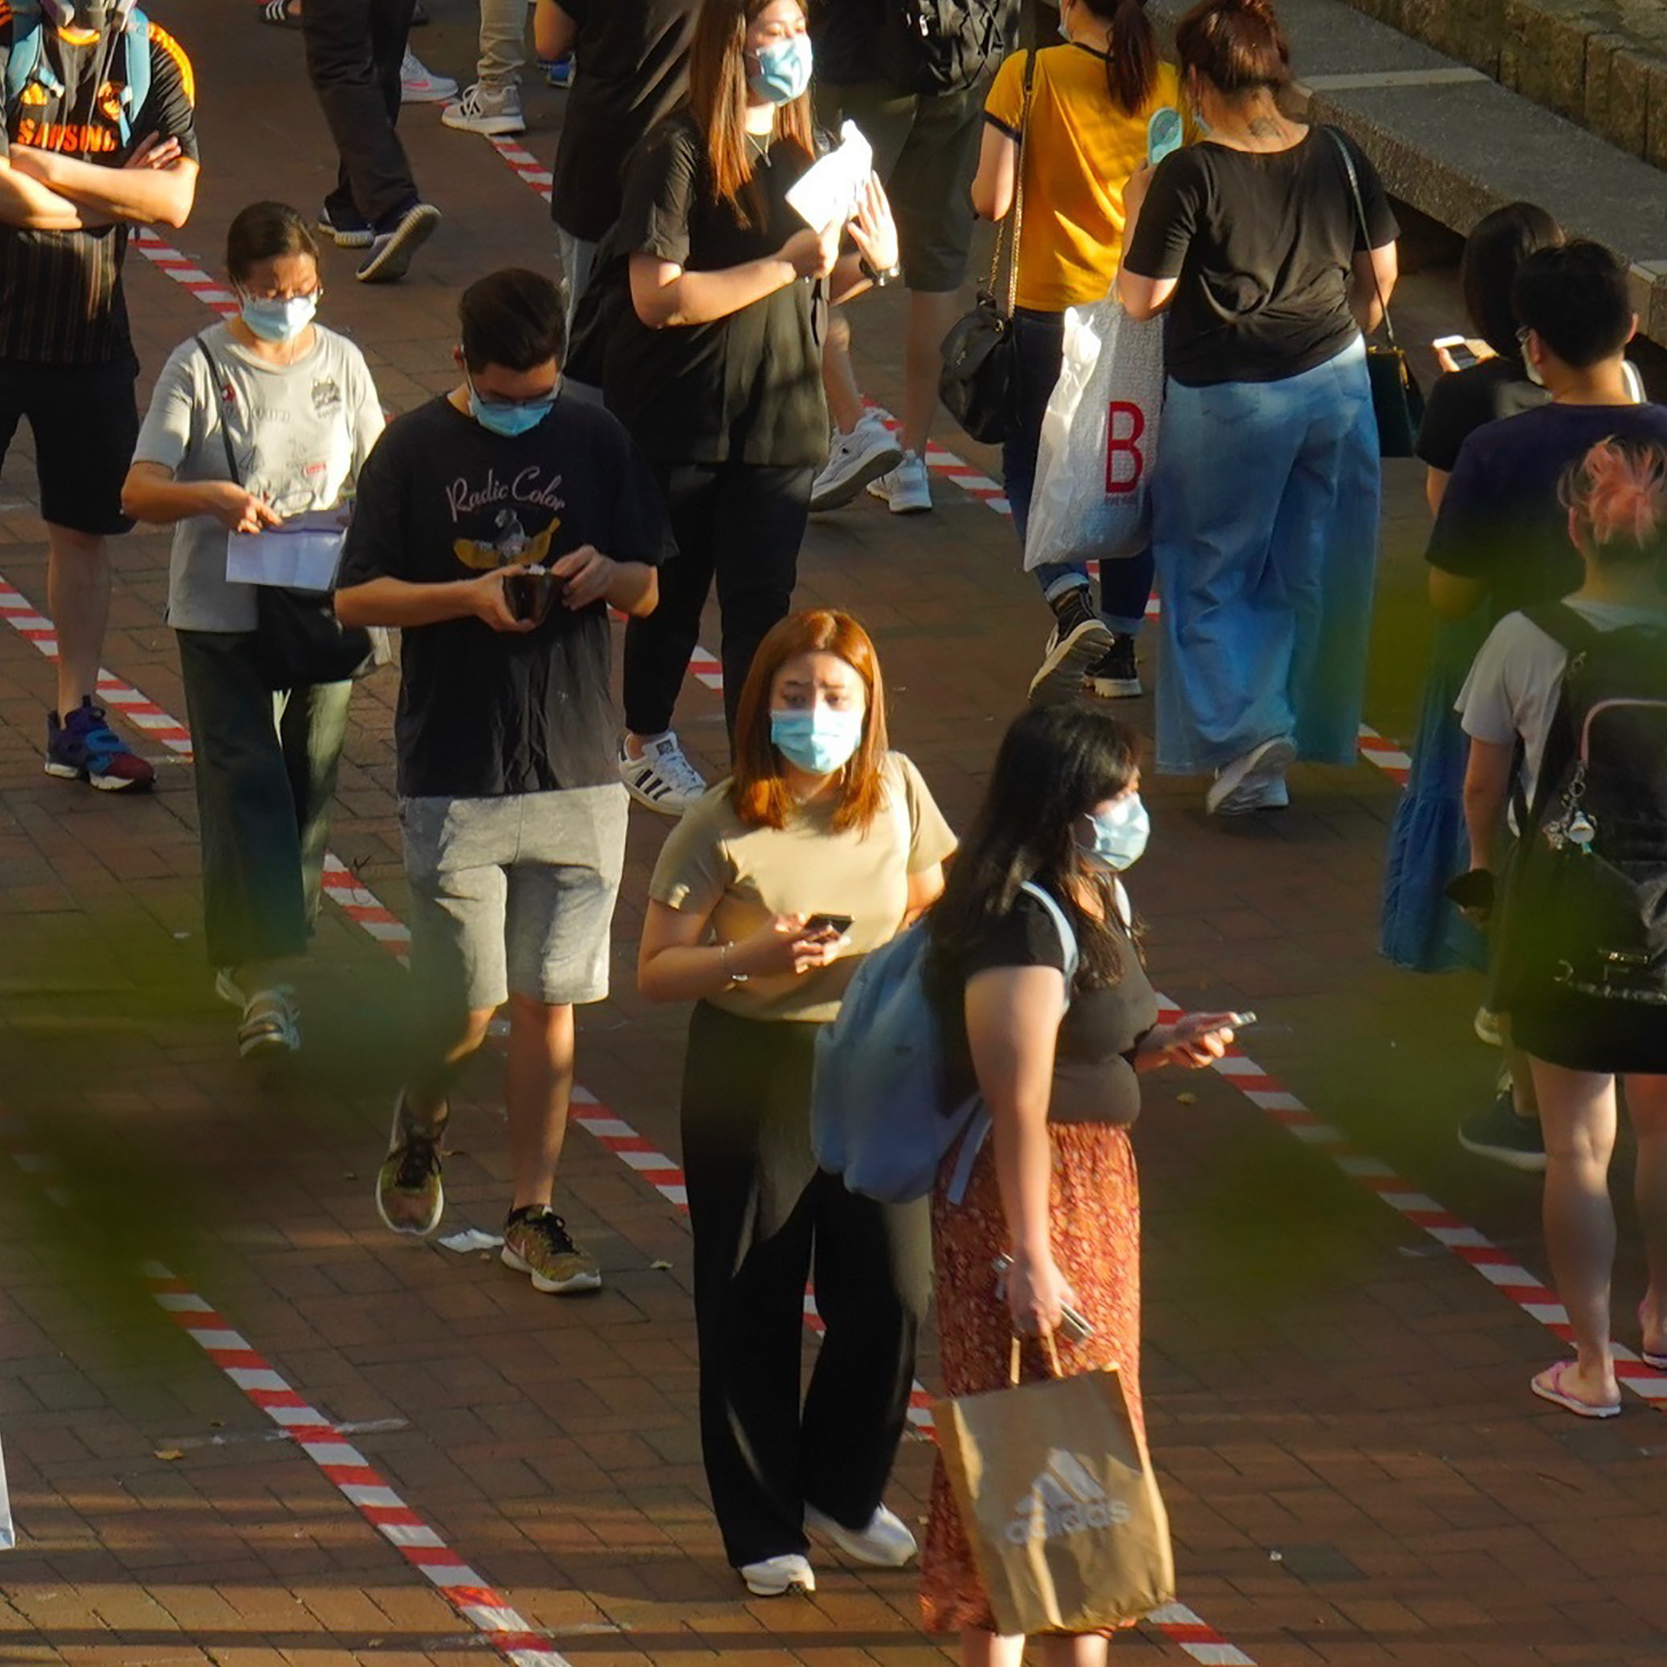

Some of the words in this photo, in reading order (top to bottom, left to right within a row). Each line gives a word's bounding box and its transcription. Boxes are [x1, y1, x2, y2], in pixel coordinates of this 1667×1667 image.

[1105, 400, 1145, 493] B
[511, 464, 566, 512] Color
[1004, 1499, 1131, 1545] adidas
